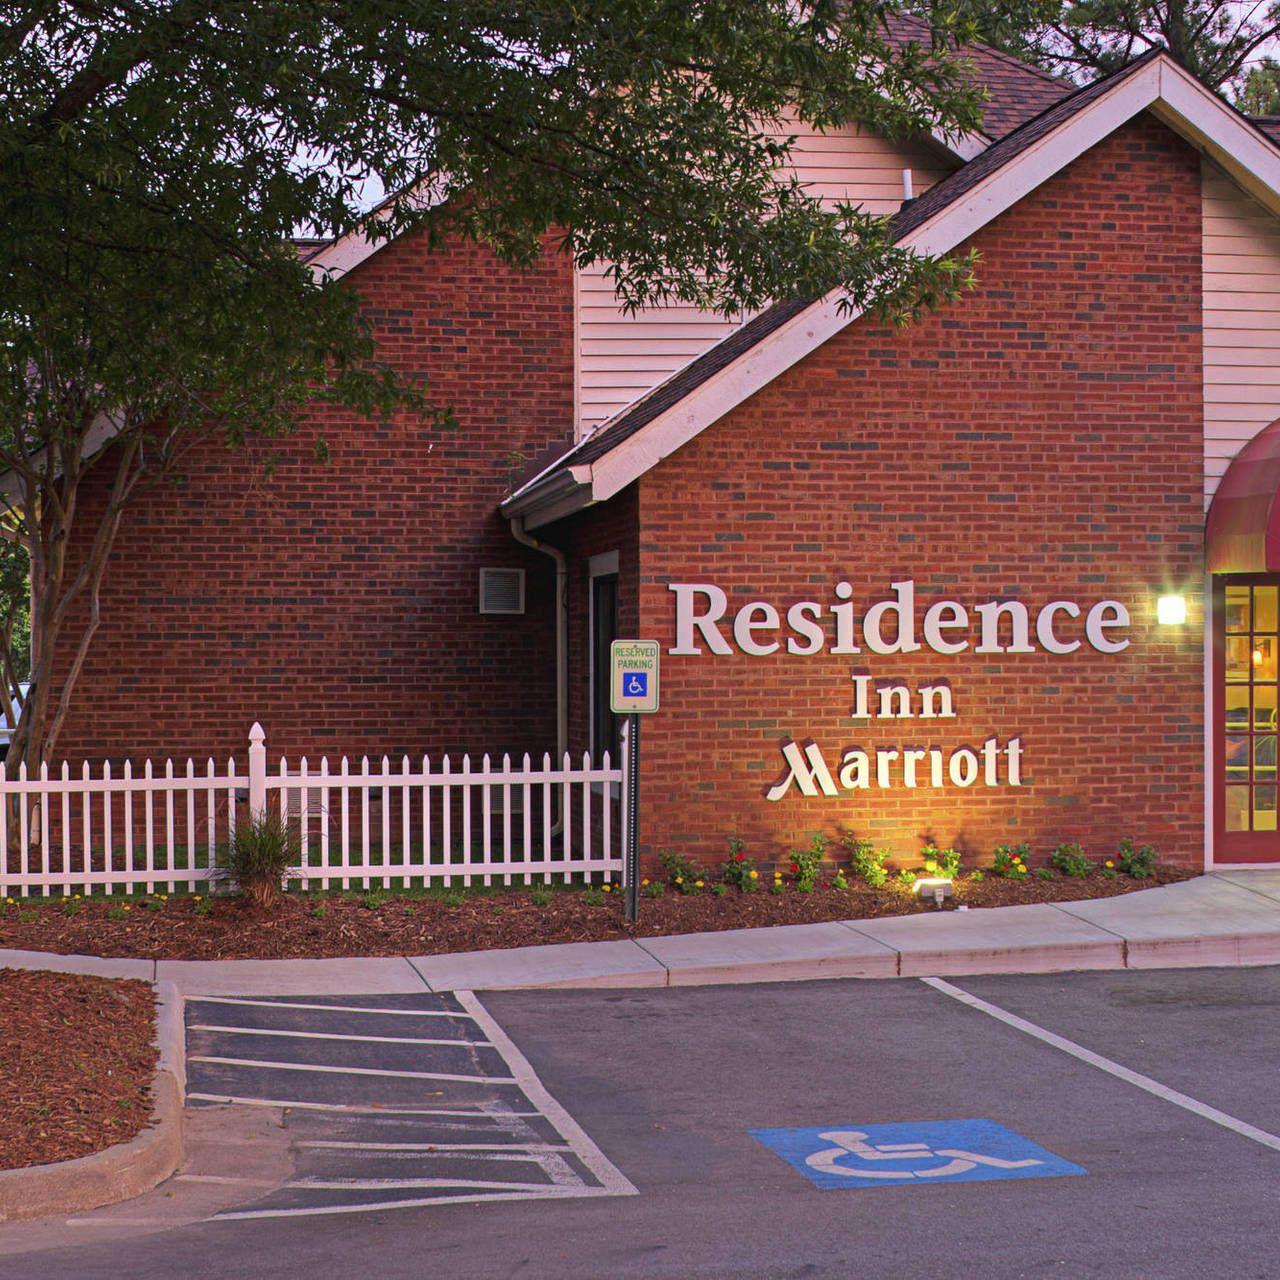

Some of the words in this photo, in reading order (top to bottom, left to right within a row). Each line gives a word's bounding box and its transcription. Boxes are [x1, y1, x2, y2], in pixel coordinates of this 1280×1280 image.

[668, 579, 1131, 656] Residence
[615, 648, 656, 657] RESERVED
[618, 660, 653, 669] PARKING
[851, 675, 957, 718] Inn
[766, 737, 1024, 801] Marriott
